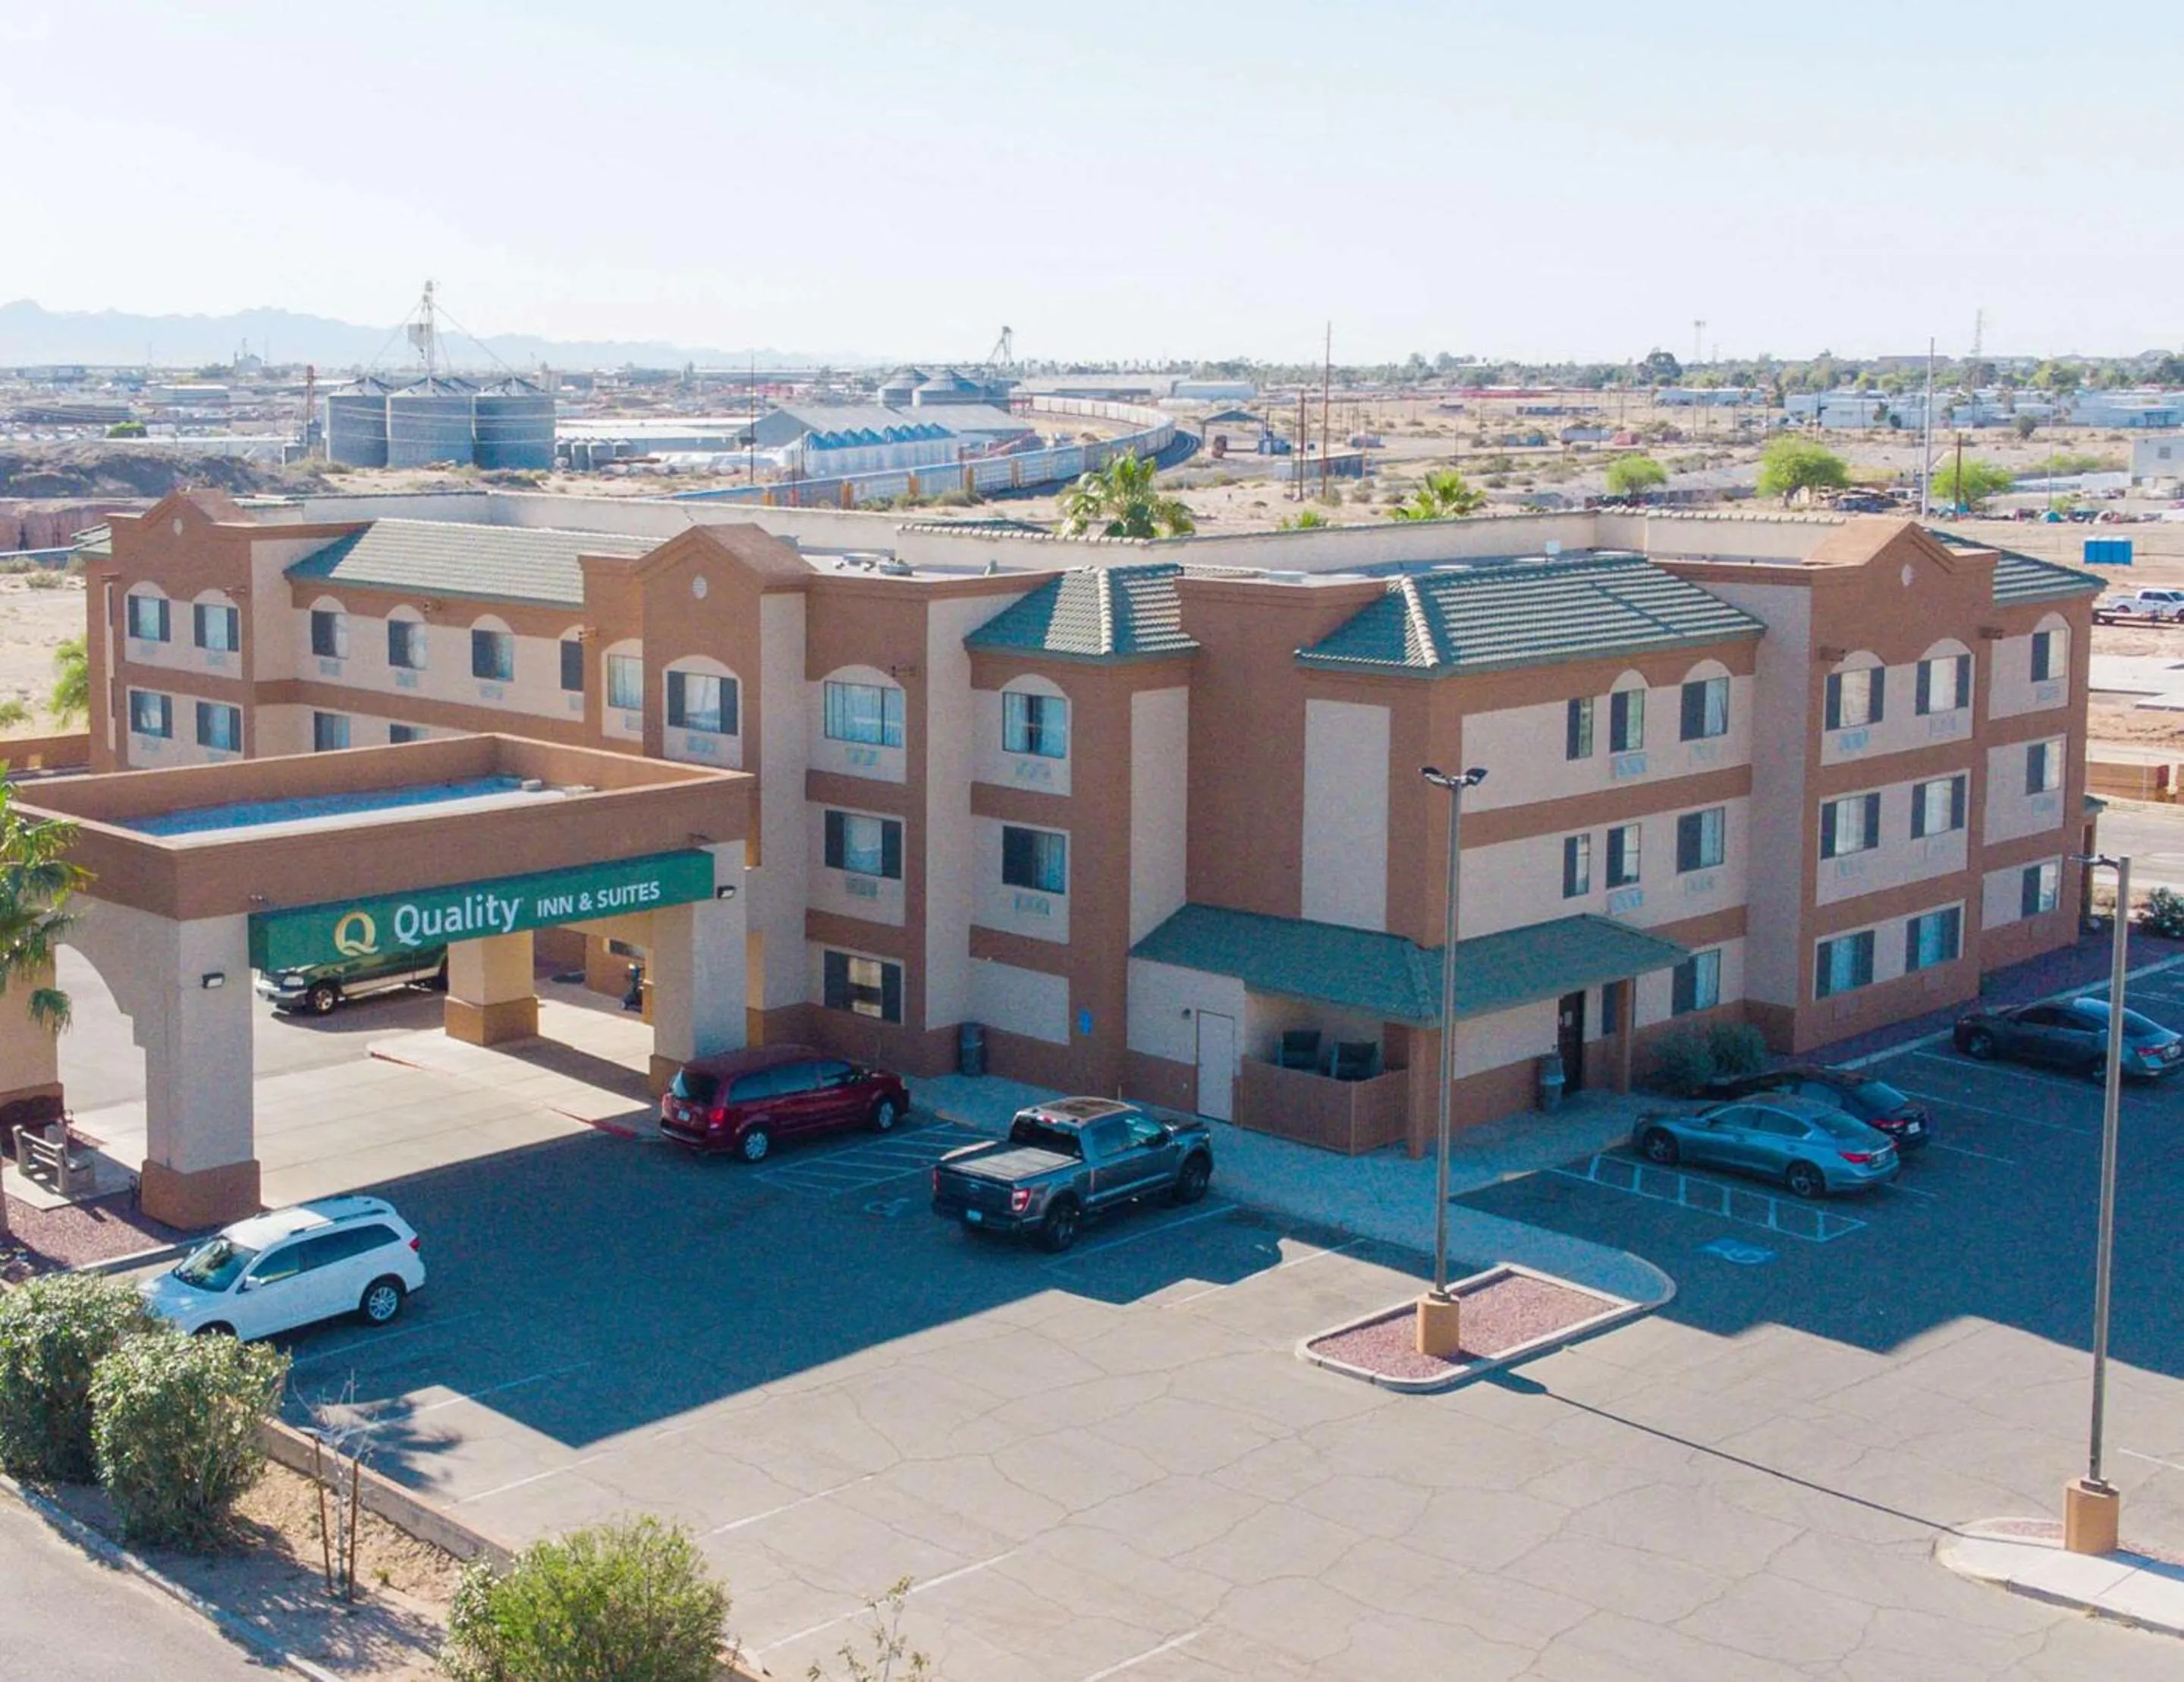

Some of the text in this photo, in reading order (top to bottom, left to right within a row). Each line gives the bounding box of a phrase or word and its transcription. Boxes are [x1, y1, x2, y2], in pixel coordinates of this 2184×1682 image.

[335, 880, 661, 957] Q Quality INN & SUITES
